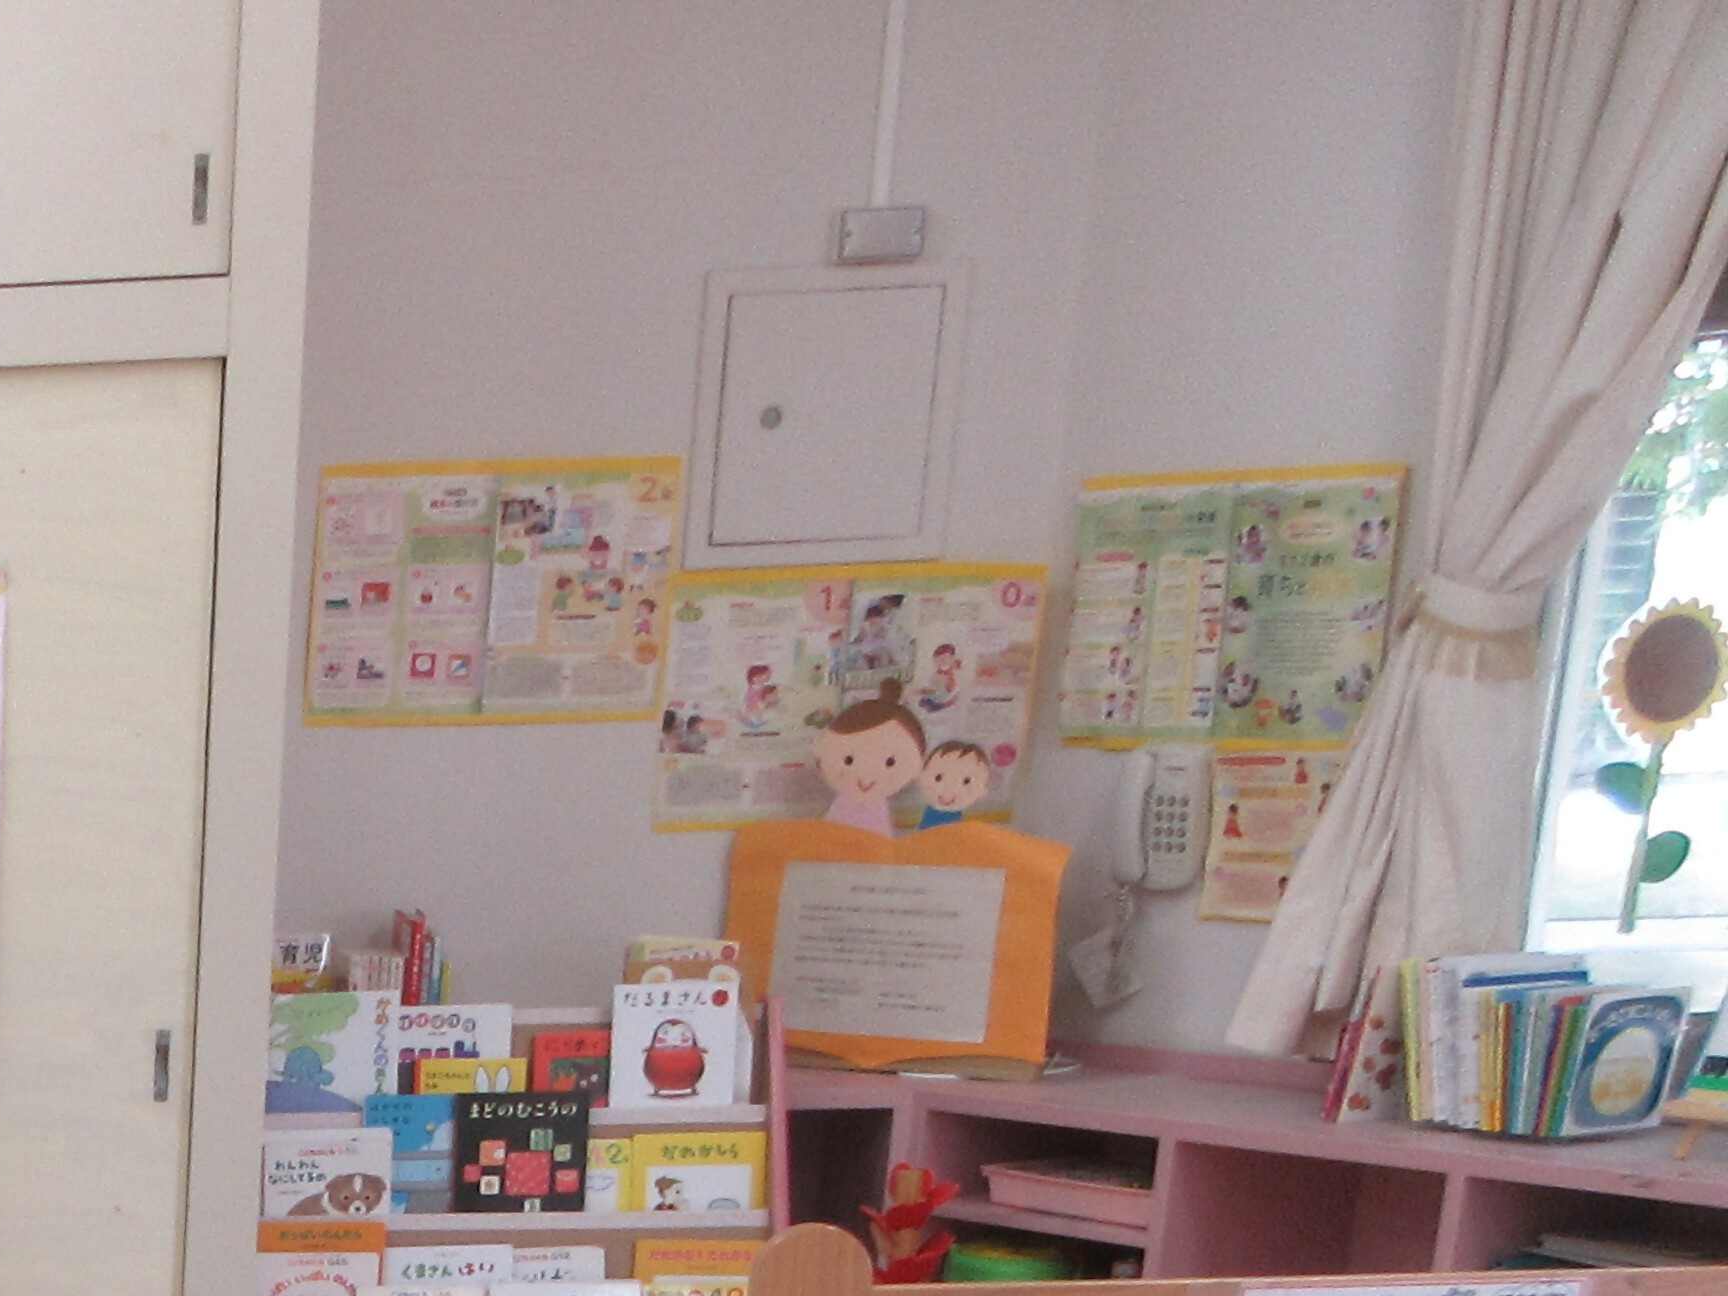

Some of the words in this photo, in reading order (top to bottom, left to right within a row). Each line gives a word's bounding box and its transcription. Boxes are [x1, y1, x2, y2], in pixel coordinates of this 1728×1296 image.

[469, 1100, 579, 1120] まどのむこうの
[401, 1262, 454, 1280] くまさん
